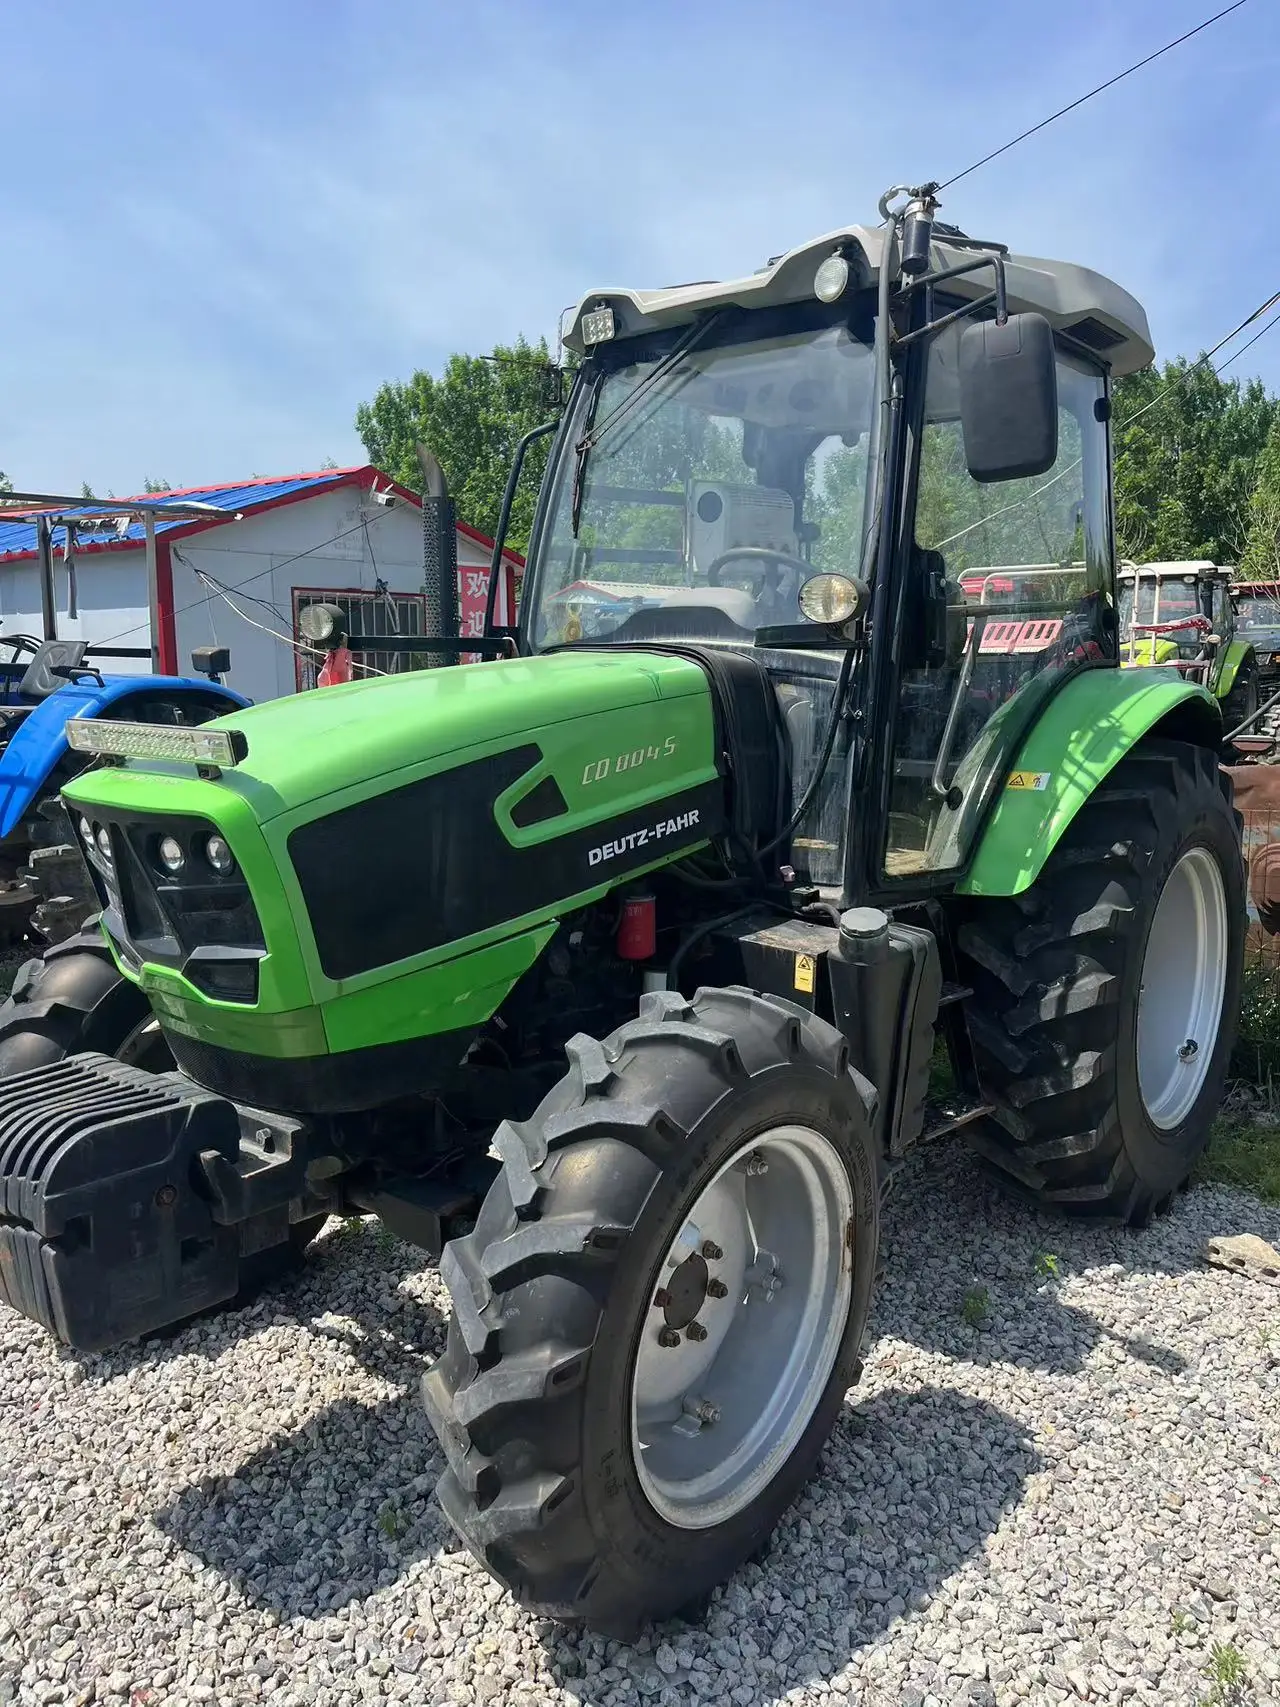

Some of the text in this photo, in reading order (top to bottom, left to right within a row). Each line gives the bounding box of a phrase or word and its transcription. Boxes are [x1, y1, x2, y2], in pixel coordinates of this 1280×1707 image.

[466, 571, 489, 663] 欢迎
[582, 758, 610, 785] CD
[588, 809, 700, 866] DEUTZ-FAHR
